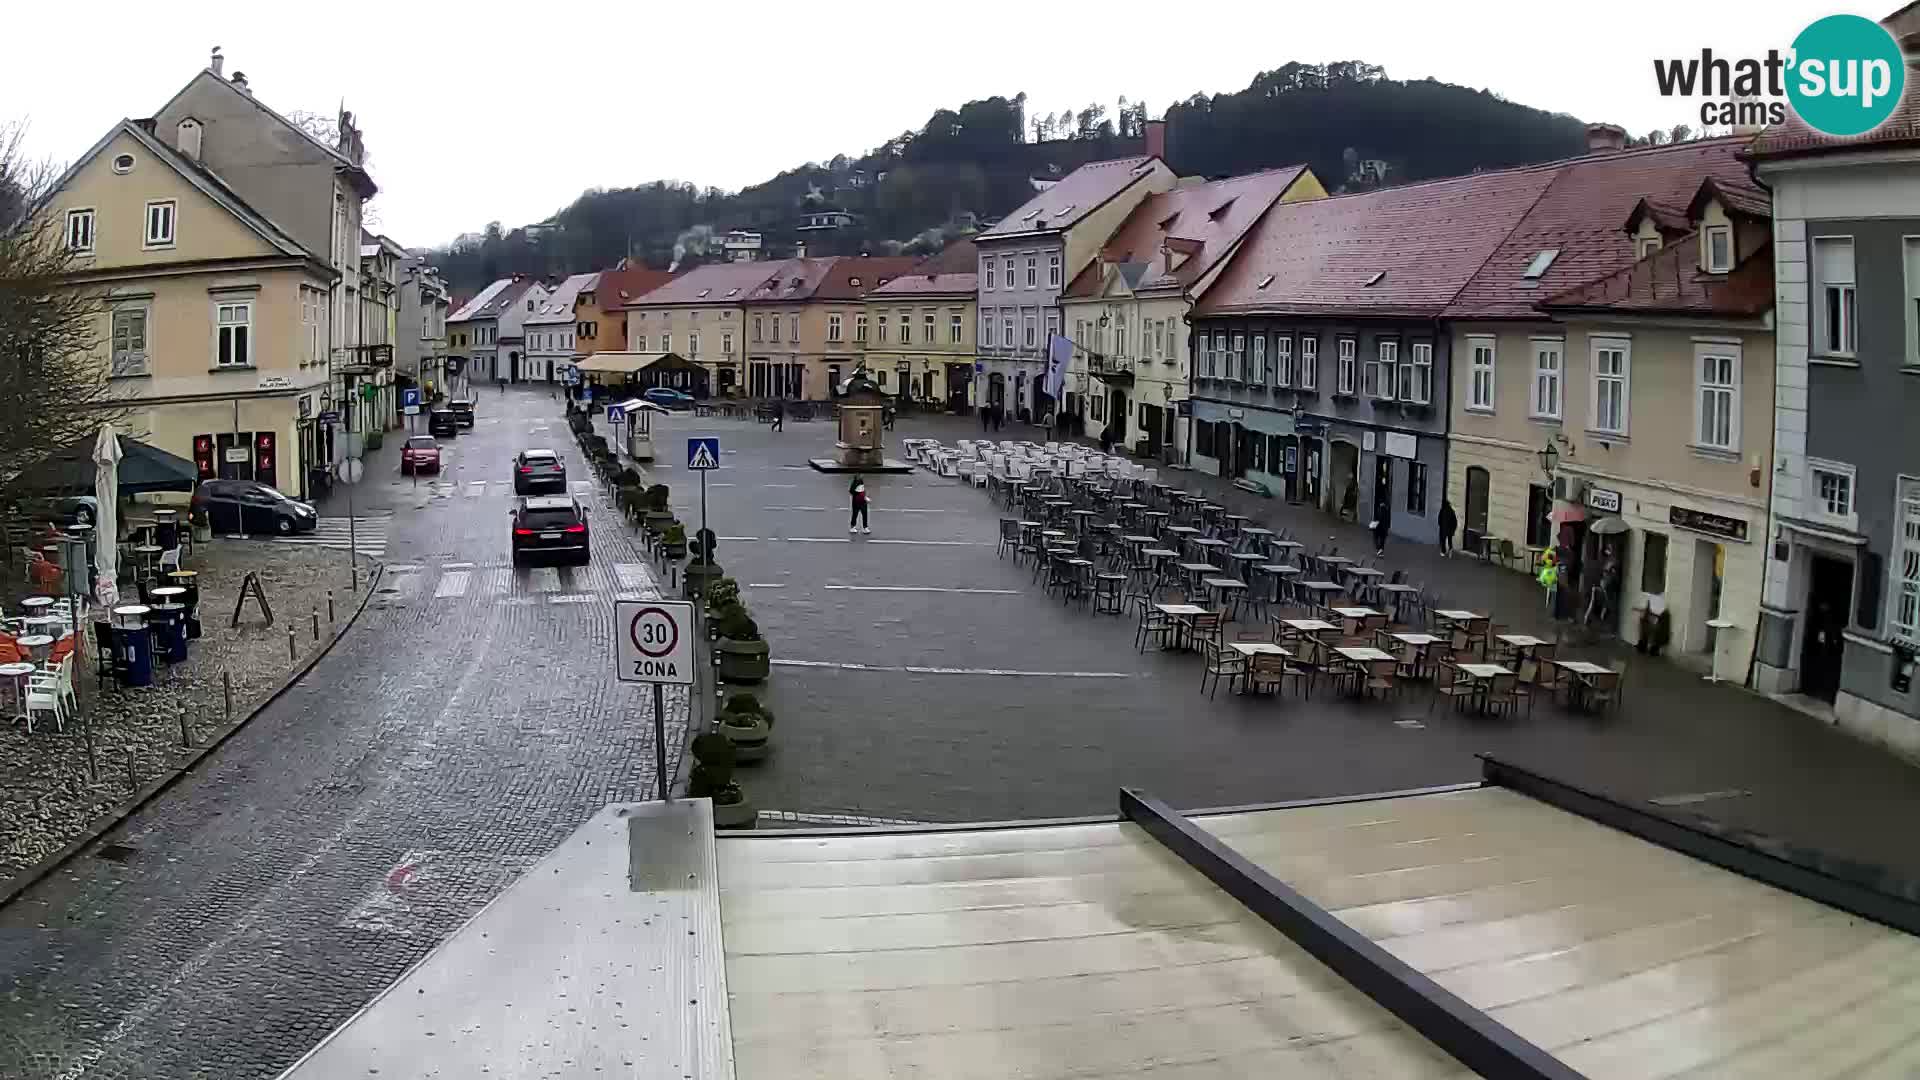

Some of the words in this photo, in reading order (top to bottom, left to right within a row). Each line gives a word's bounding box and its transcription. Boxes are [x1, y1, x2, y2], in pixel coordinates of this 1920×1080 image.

[407, 392, 416, 403] P
[643, 623, 667, 644] 30
[633, 661, 677, 677] ZONA
